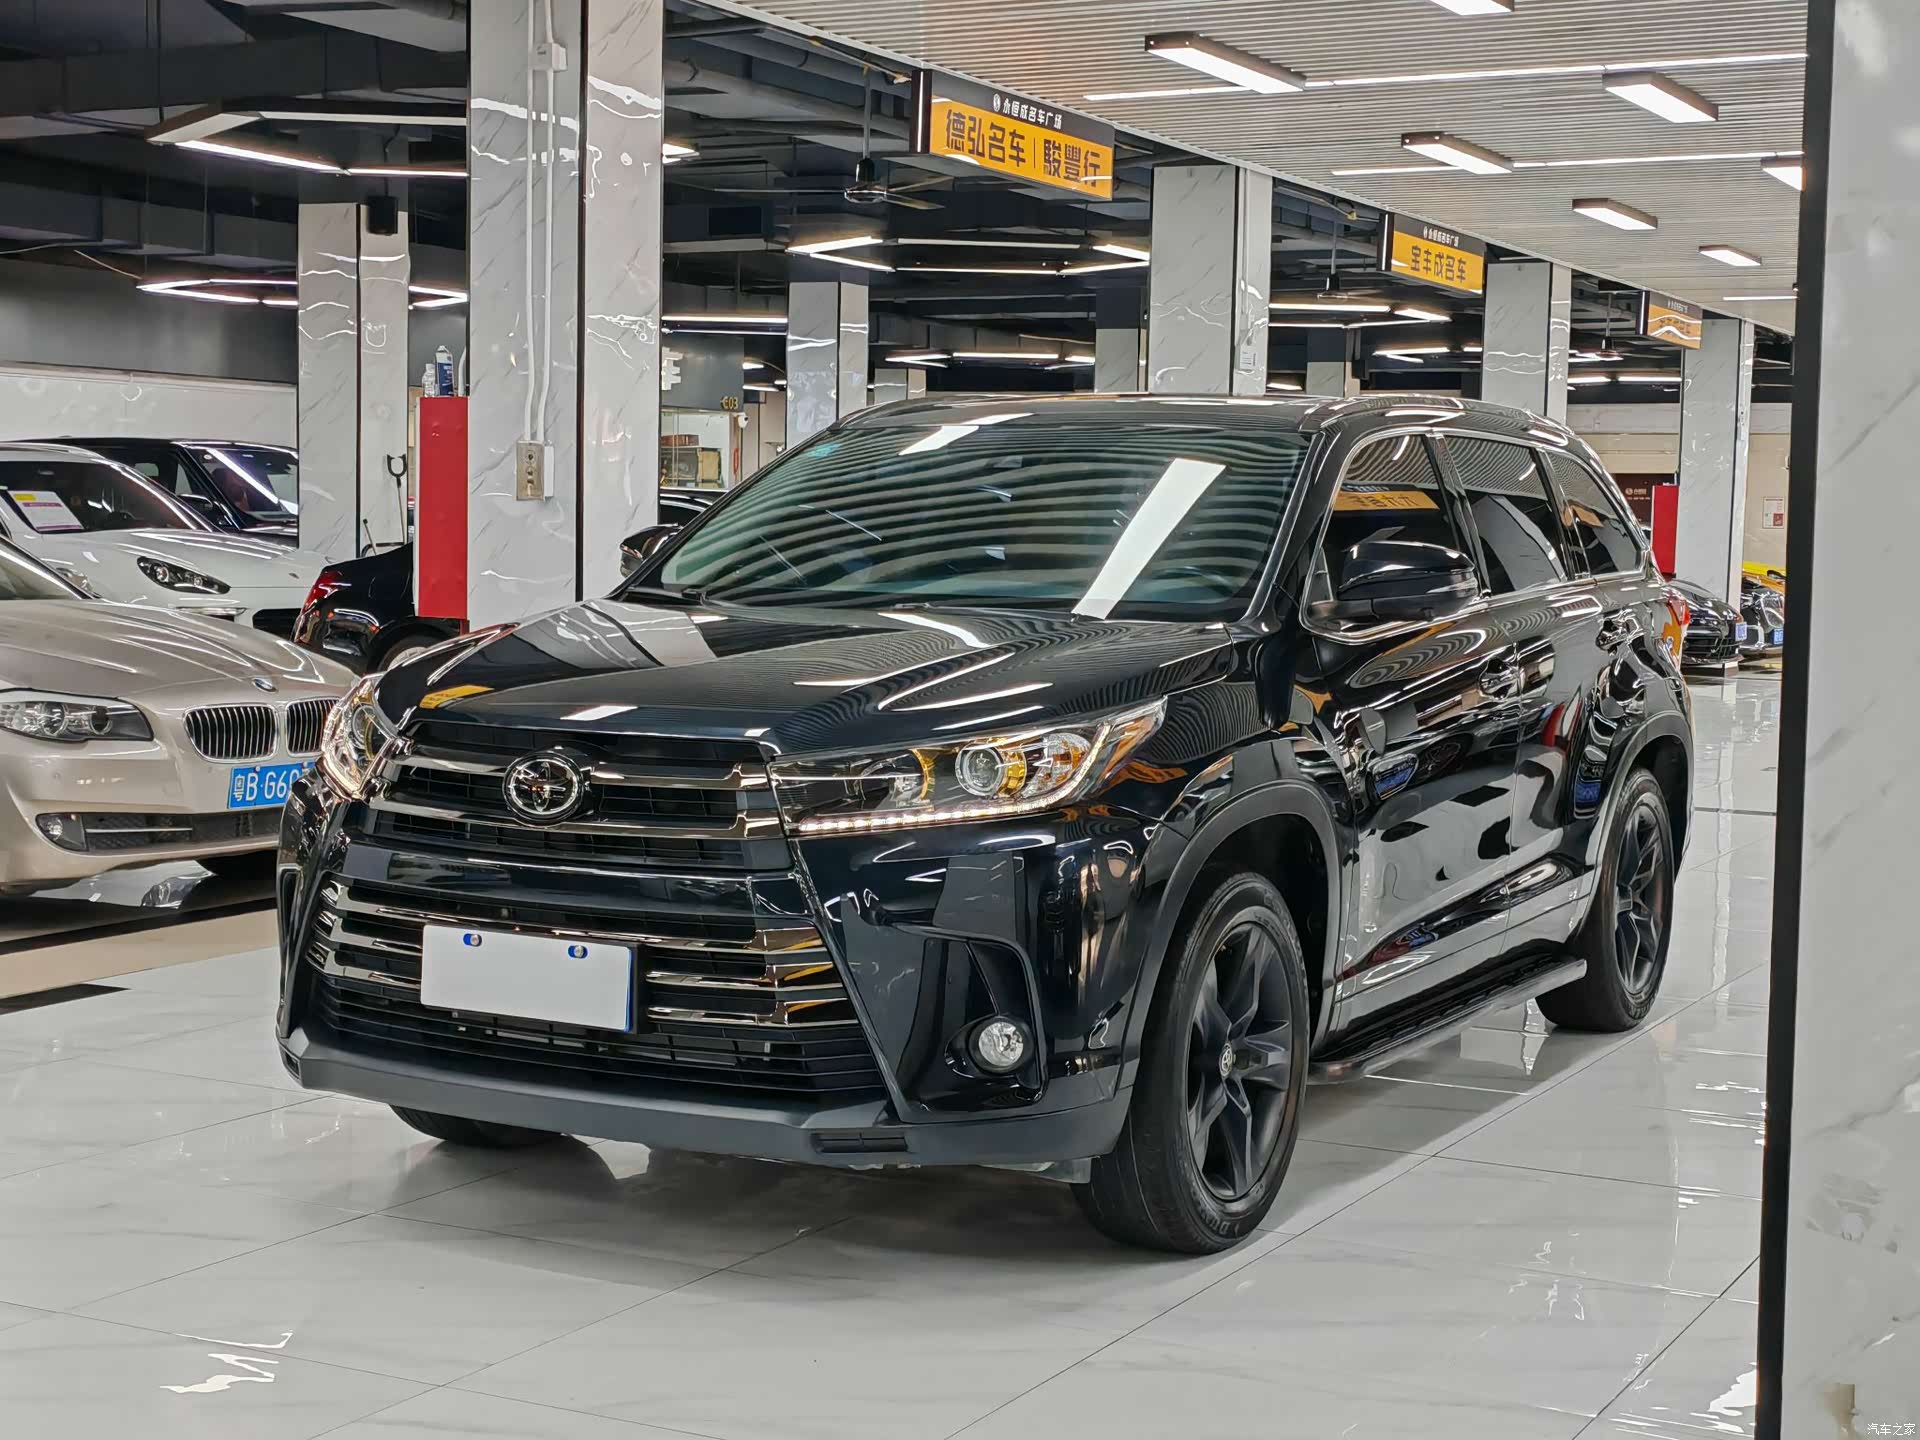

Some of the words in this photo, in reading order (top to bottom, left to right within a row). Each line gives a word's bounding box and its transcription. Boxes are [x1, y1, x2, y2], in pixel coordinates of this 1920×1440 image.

[946, 109, 1026, 168] 德弘名车
[1411, 245, 1466, 283] 宝丰成名车
